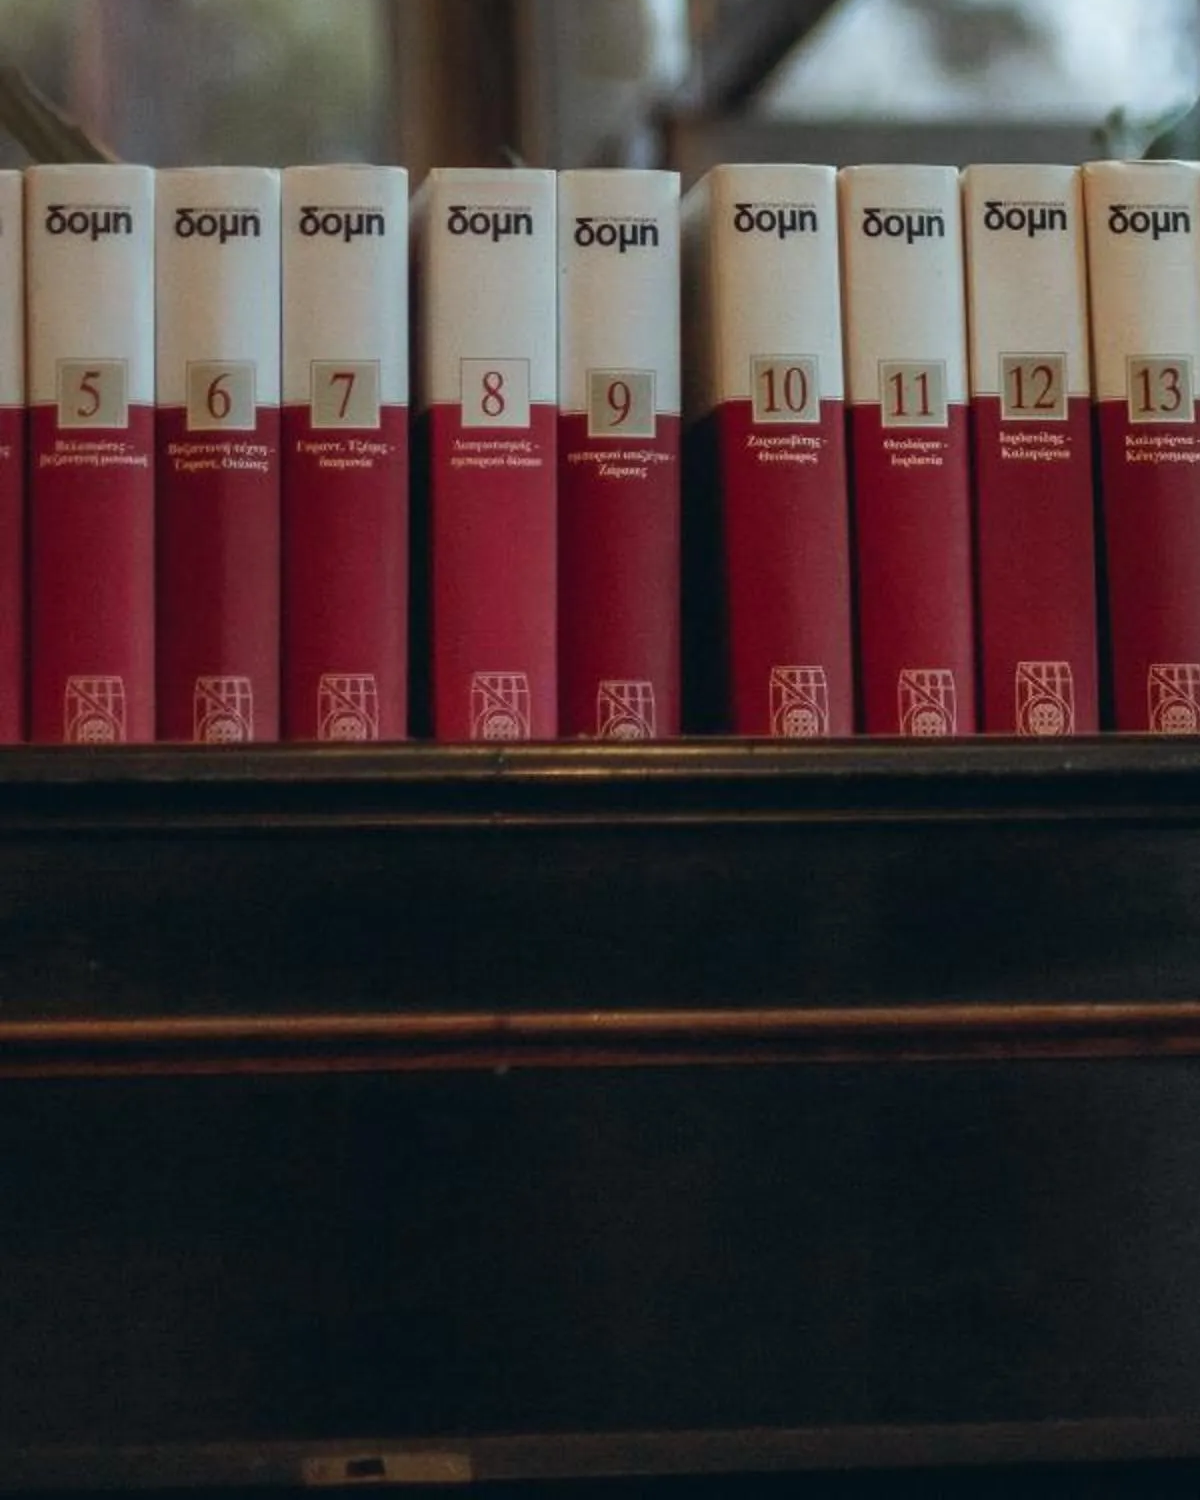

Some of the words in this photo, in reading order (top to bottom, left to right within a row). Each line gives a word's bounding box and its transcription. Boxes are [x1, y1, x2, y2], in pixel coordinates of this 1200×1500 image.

[77, 371, 101, 418] 5
[206, 373, 231, 420] 6
[330, 372, 356, 418] 7
[481, 371, 505, 417] 8
[607, 381, 631, 426] 9
[761, 367, 807, 412] 10
[890, 372, 930, 417] 11
[1011, 365, 1055, 409] 12
[1138, 367, 1182, 413] 13
